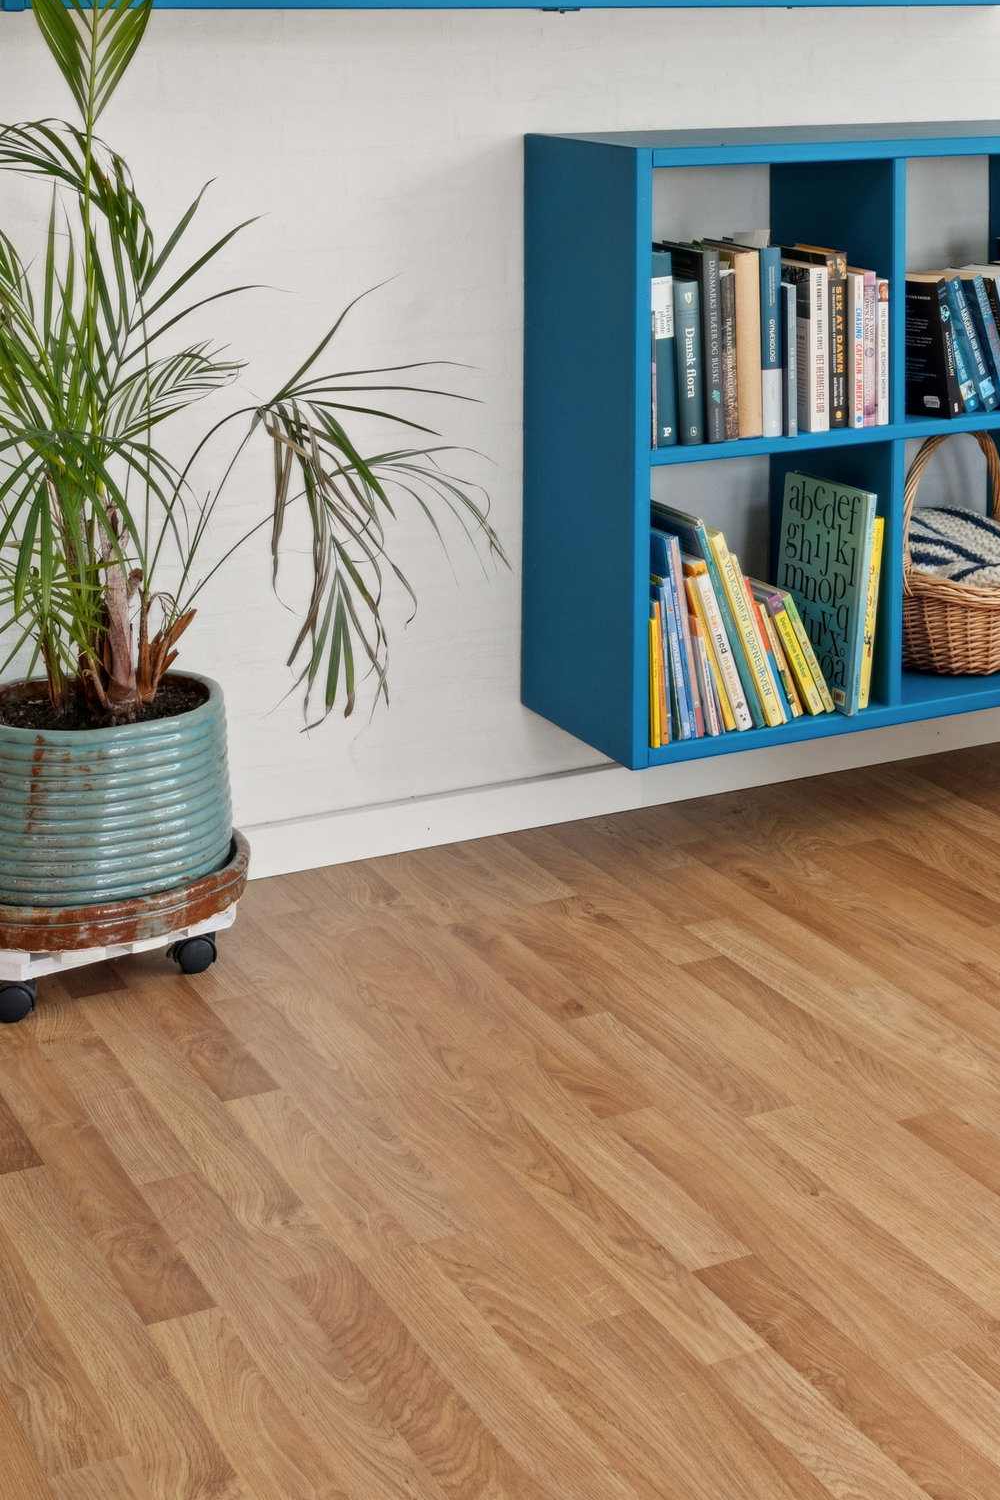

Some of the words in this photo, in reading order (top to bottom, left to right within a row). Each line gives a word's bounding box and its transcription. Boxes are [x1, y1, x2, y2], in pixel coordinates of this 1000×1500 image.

[708, 260, 717, 309] DANMARKS
[835, 286, 843, 311] SEX
[664, 304, 672, 333] hvilken
[710, 311, 718, 339] TRÆER
[836, 315, 843, 330] AT
[960, 308, 976, 340] KRIGEREN
[685, 326, 695, 366] Dansk
[711, 342, 718, 355] OG
[768, 319, 776, 363] GYNÆKOLOGI
[836, 335, 844, 373] DAWN
[945, 331, 955, 377] MOCKINGJAY
[711, 357, 719, 384] BUSKE
[815, 354, 824, 365] DET
[686, 368, 697, 398] flora
[815, 366, 824, 401] HEMMELIGE
[816, 403, 825, 413] LØB
[723, 561, 748, 622] VELKOMMEN
[745, 630, 772, 696] BØRNEHAVEN
[779, 617, 789, 631] Den
[782, 632, 797, 654] grønne
[715, 633, 727, 655] med
[722, 656, 741, 700] maskiner!
[792, 654, 807, 678] traktor
